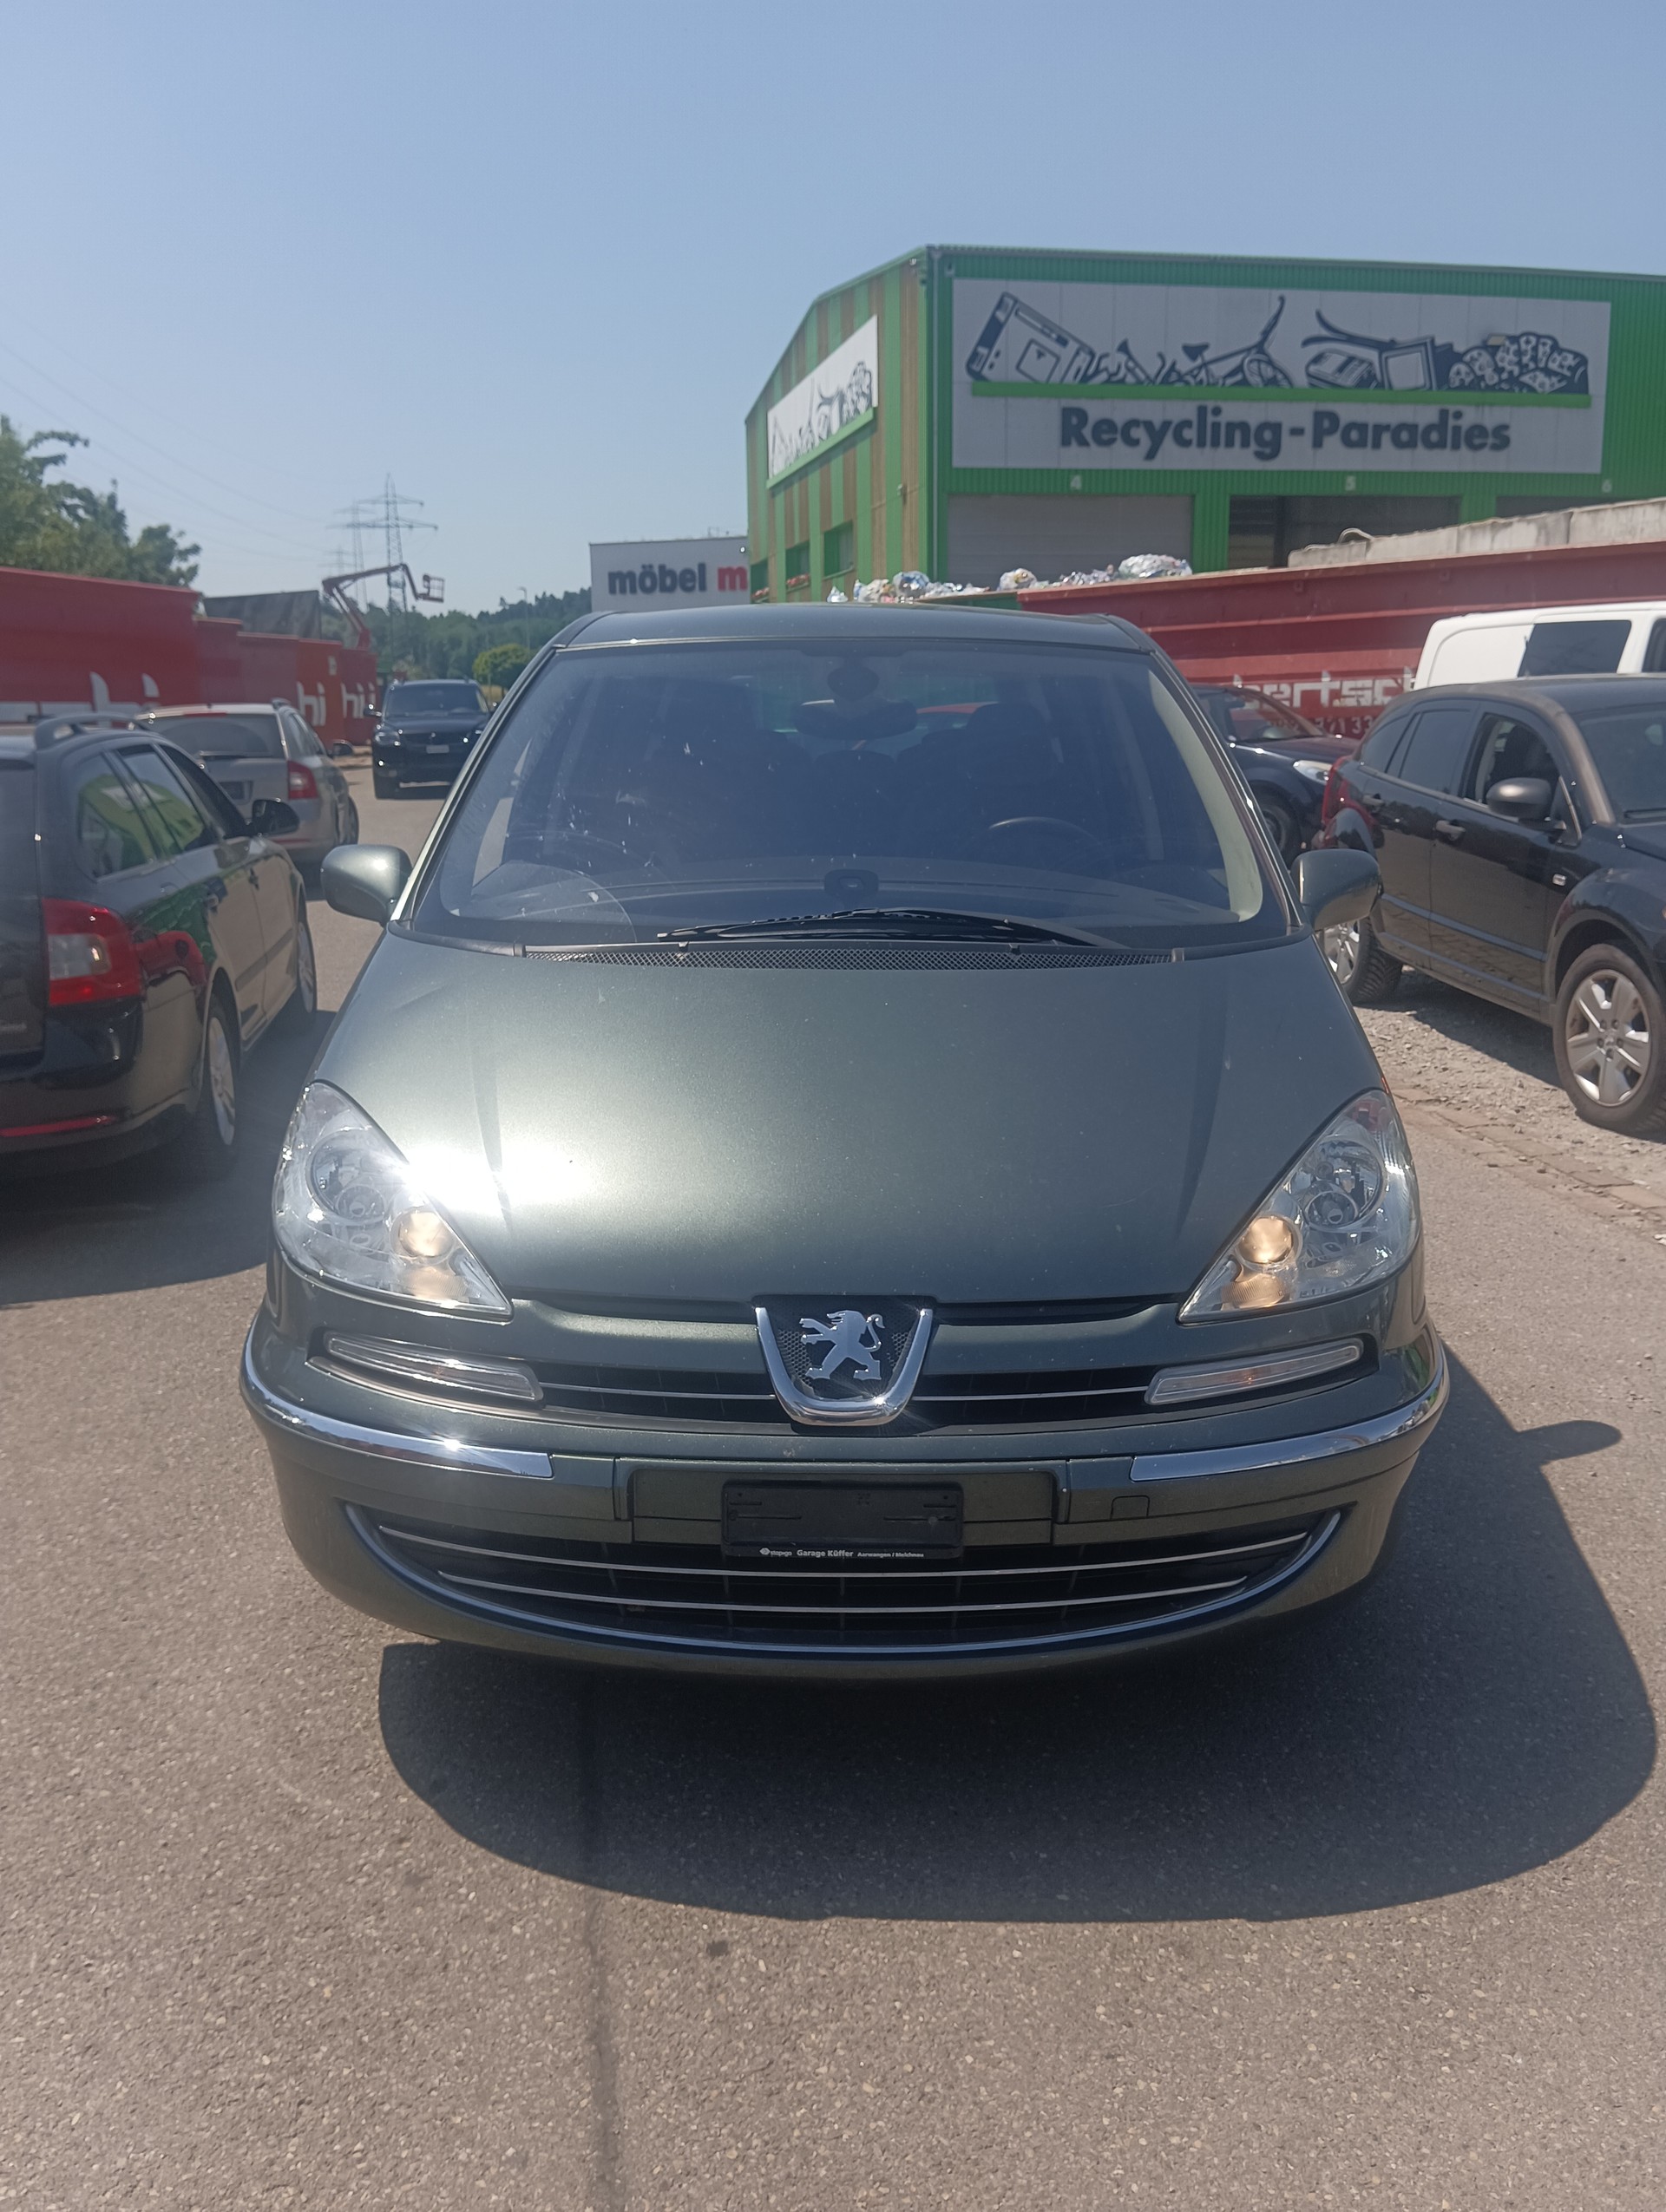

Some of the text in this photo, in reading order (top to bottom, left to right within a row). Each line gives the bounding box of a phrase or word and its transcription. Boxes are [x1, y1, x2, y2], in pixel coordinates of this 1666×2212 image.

[608, 562, 707, 595] möbel
[797, 1549, 825, 1558] Garage
[827, 1548, 854, 1557] Küffer
